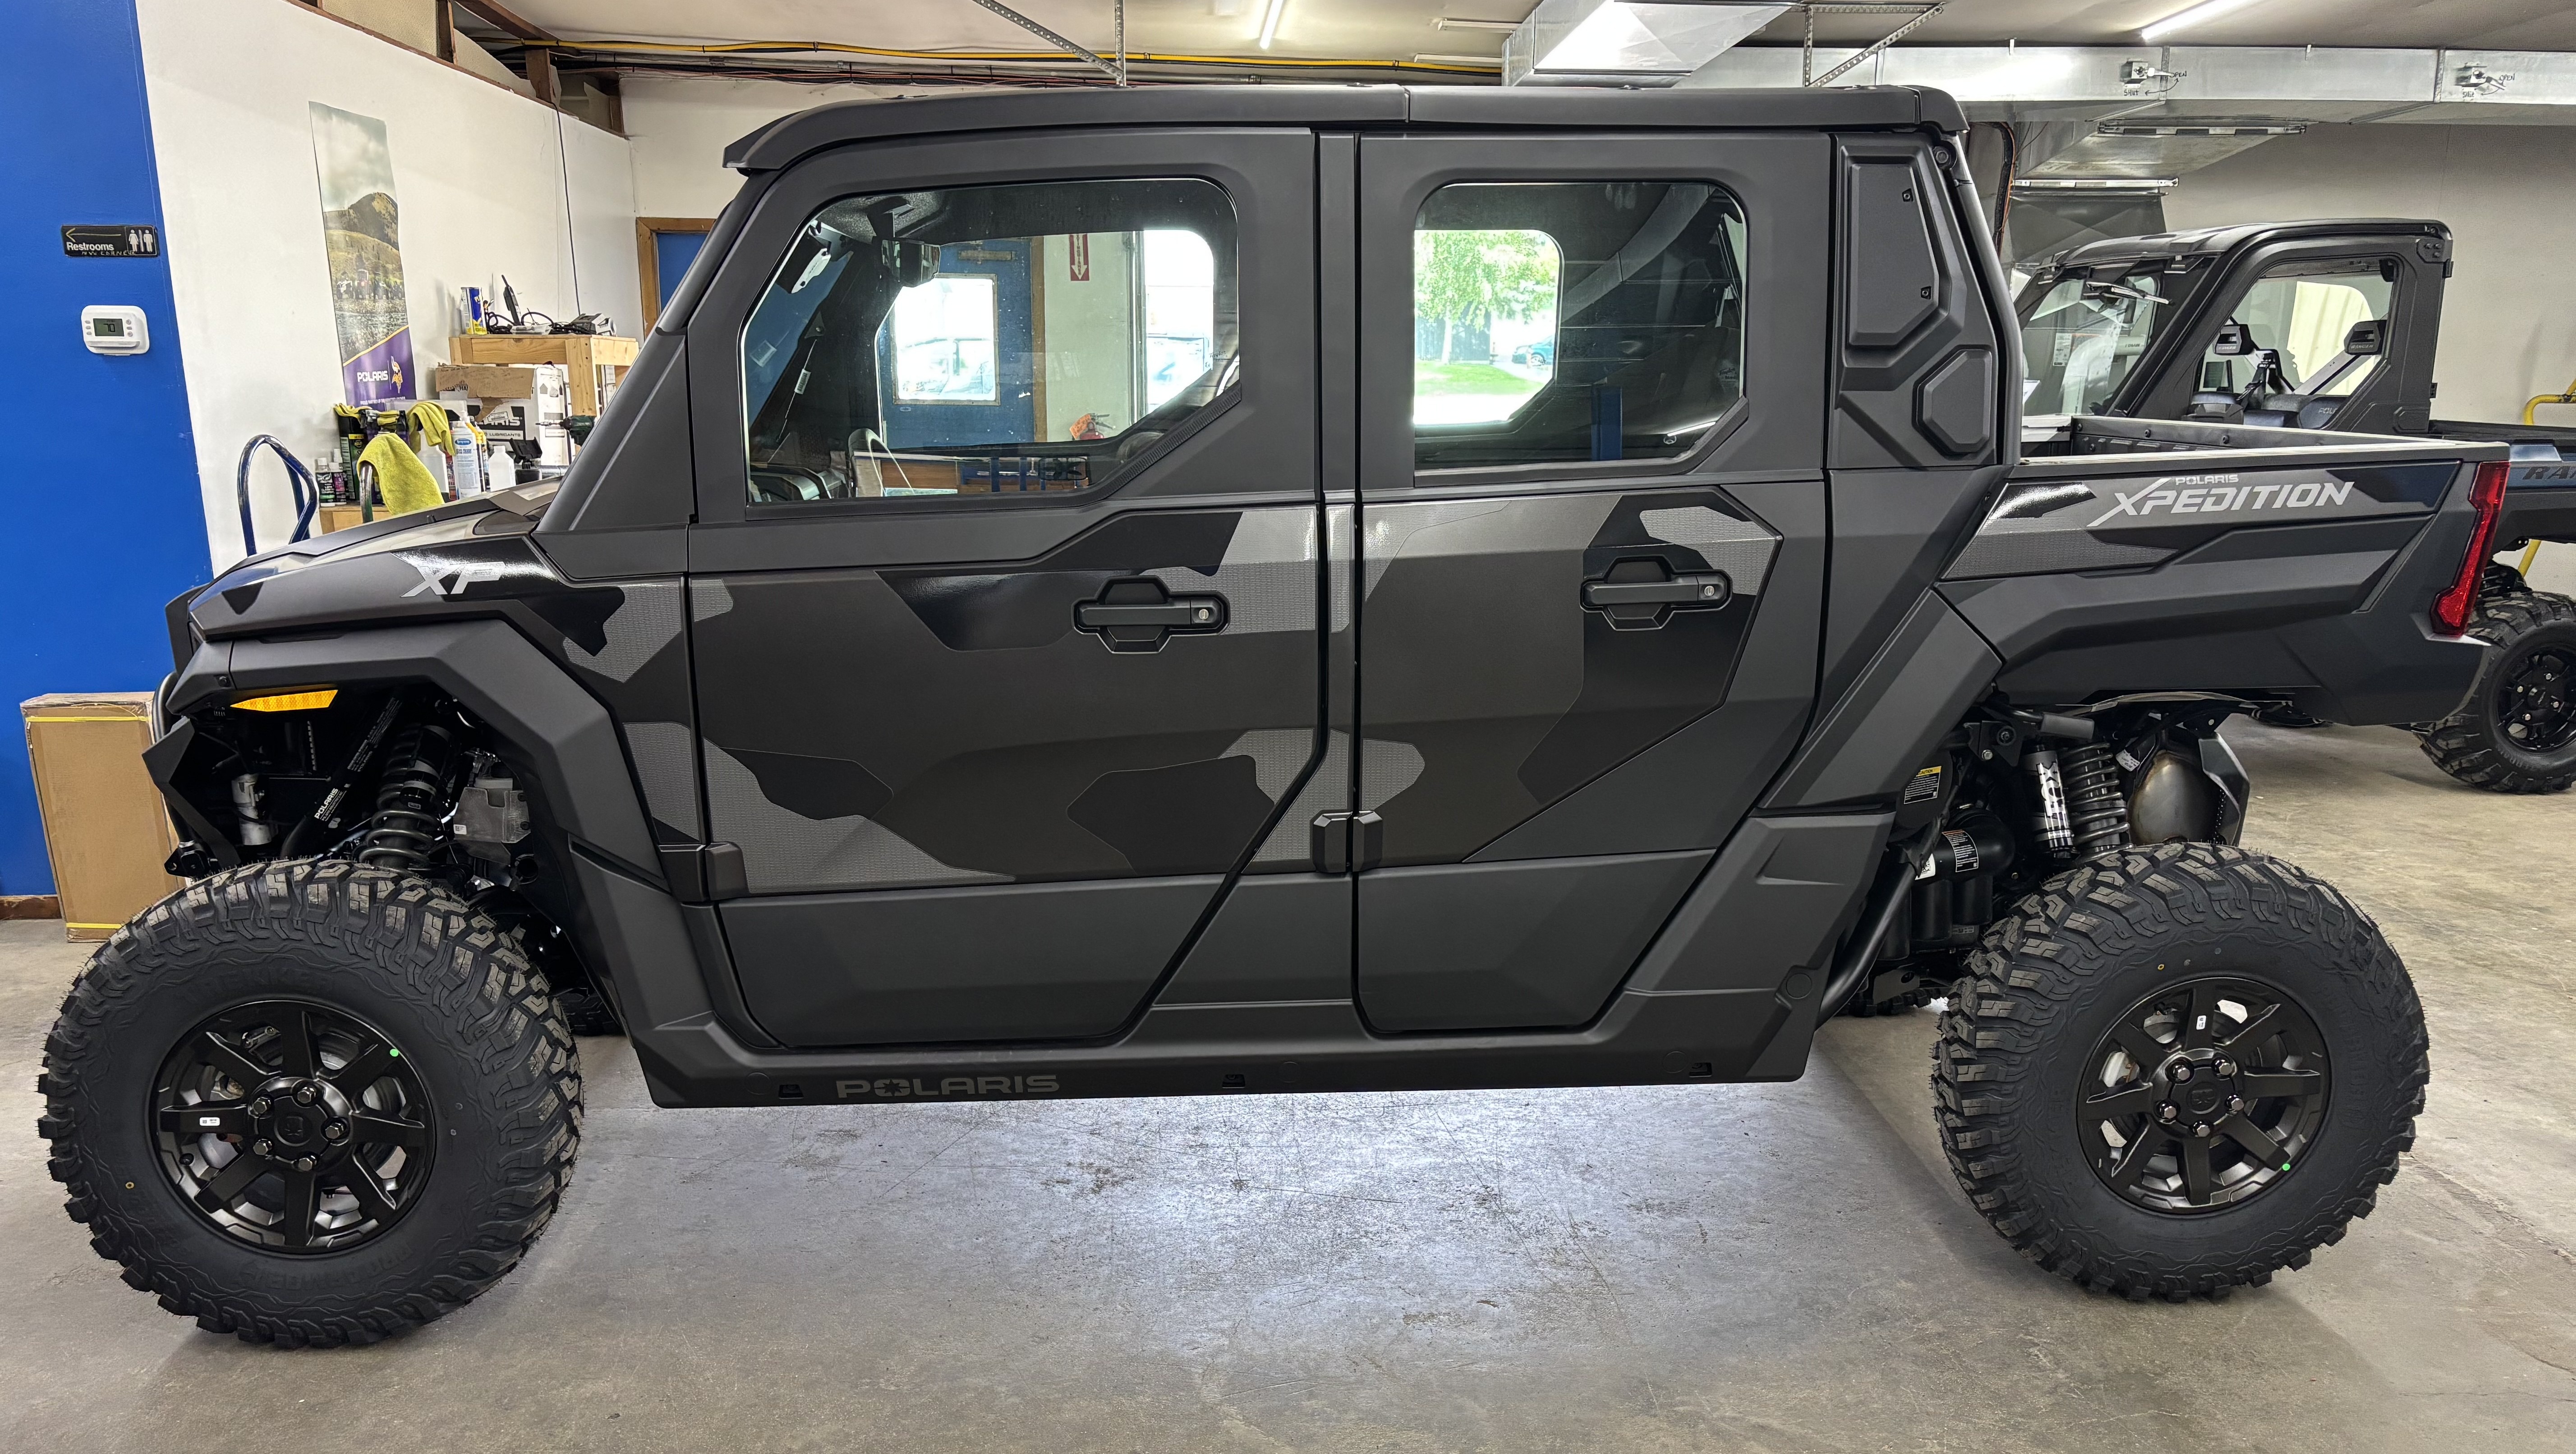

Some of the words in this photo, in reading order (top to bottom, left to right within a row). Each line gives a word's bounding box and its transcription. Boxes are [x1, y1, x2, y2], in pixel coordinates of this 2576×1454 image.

[66, 242, 115, 251] Restrooms
[103, 323, 115, 332] 70
[357, 370, 388, 382] POLARIS
[2175, 474, 2239, 486] POLARIS
[2086, 478, 2355, 527] XPEDITION
[400, 561, 506, 597] XP
[314, 788, 338, 819] POLARIS
[836, 1075, 1060, 1098] POLARIS
